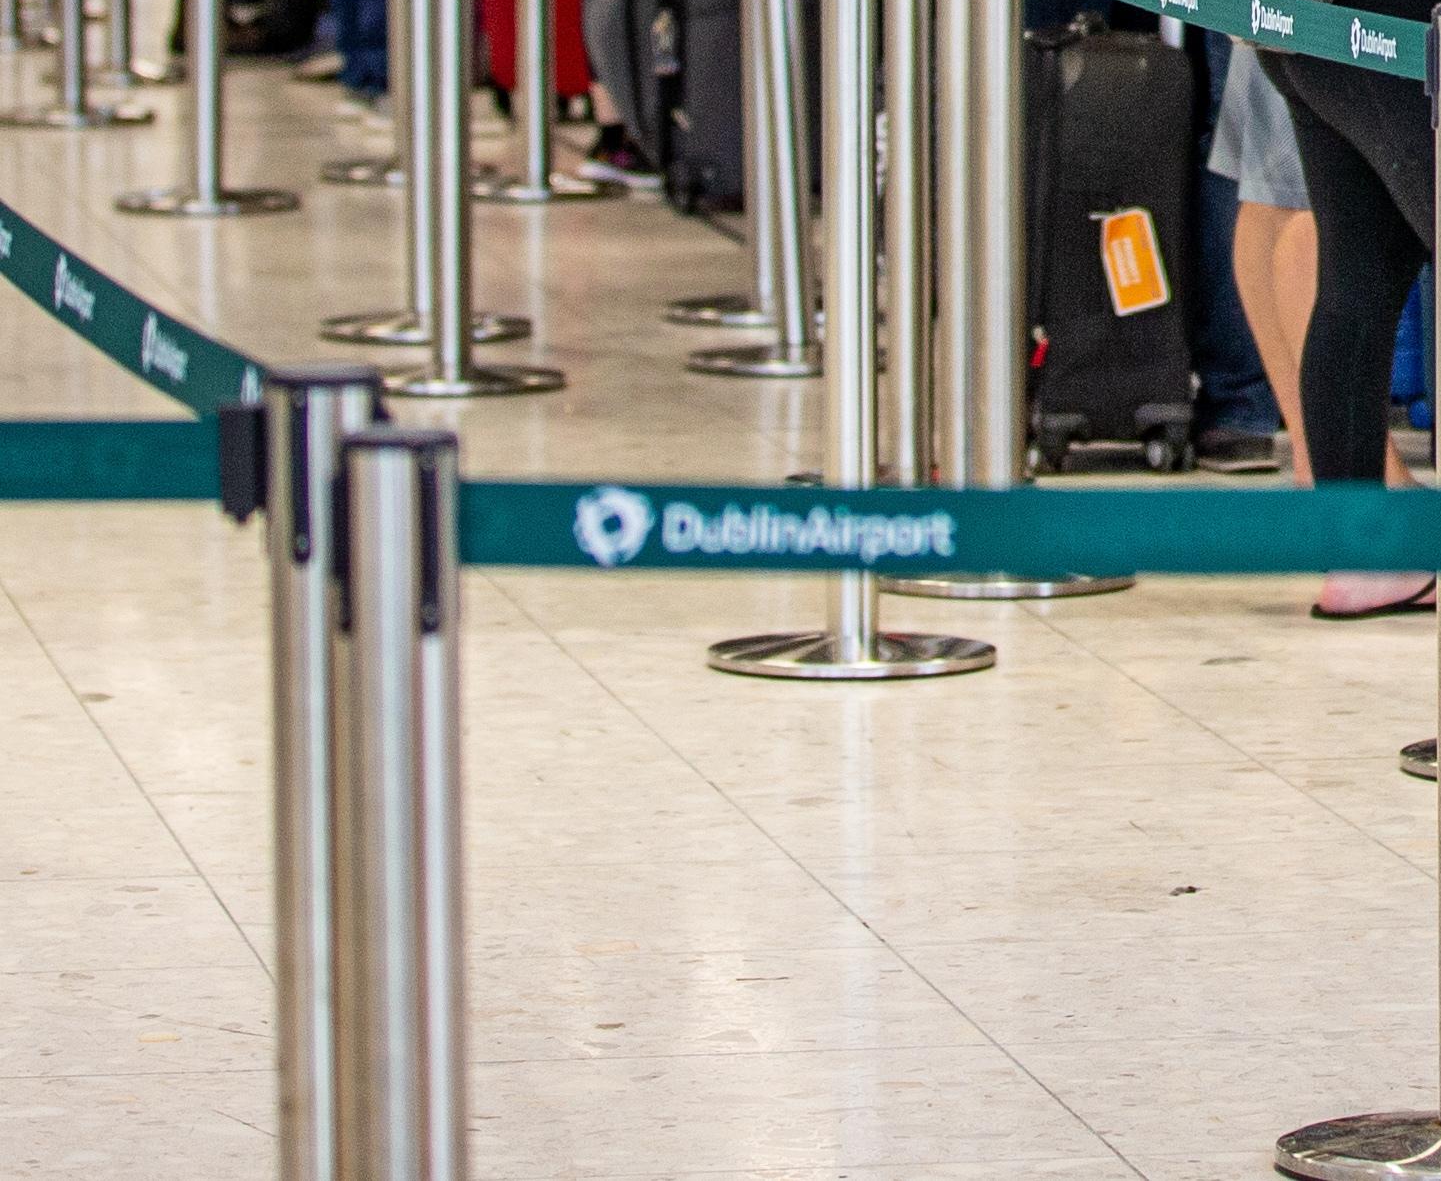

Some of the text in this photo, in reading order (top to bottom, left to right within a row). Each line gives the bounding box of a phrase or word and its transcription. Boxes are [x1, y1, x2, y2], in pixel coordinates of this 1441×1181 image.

[1260, 5, 1294, 38] DublinAirport
[1361, 27, 1398, 62] DublinAirport
[661, 500, 957, 564] DublinAirport
